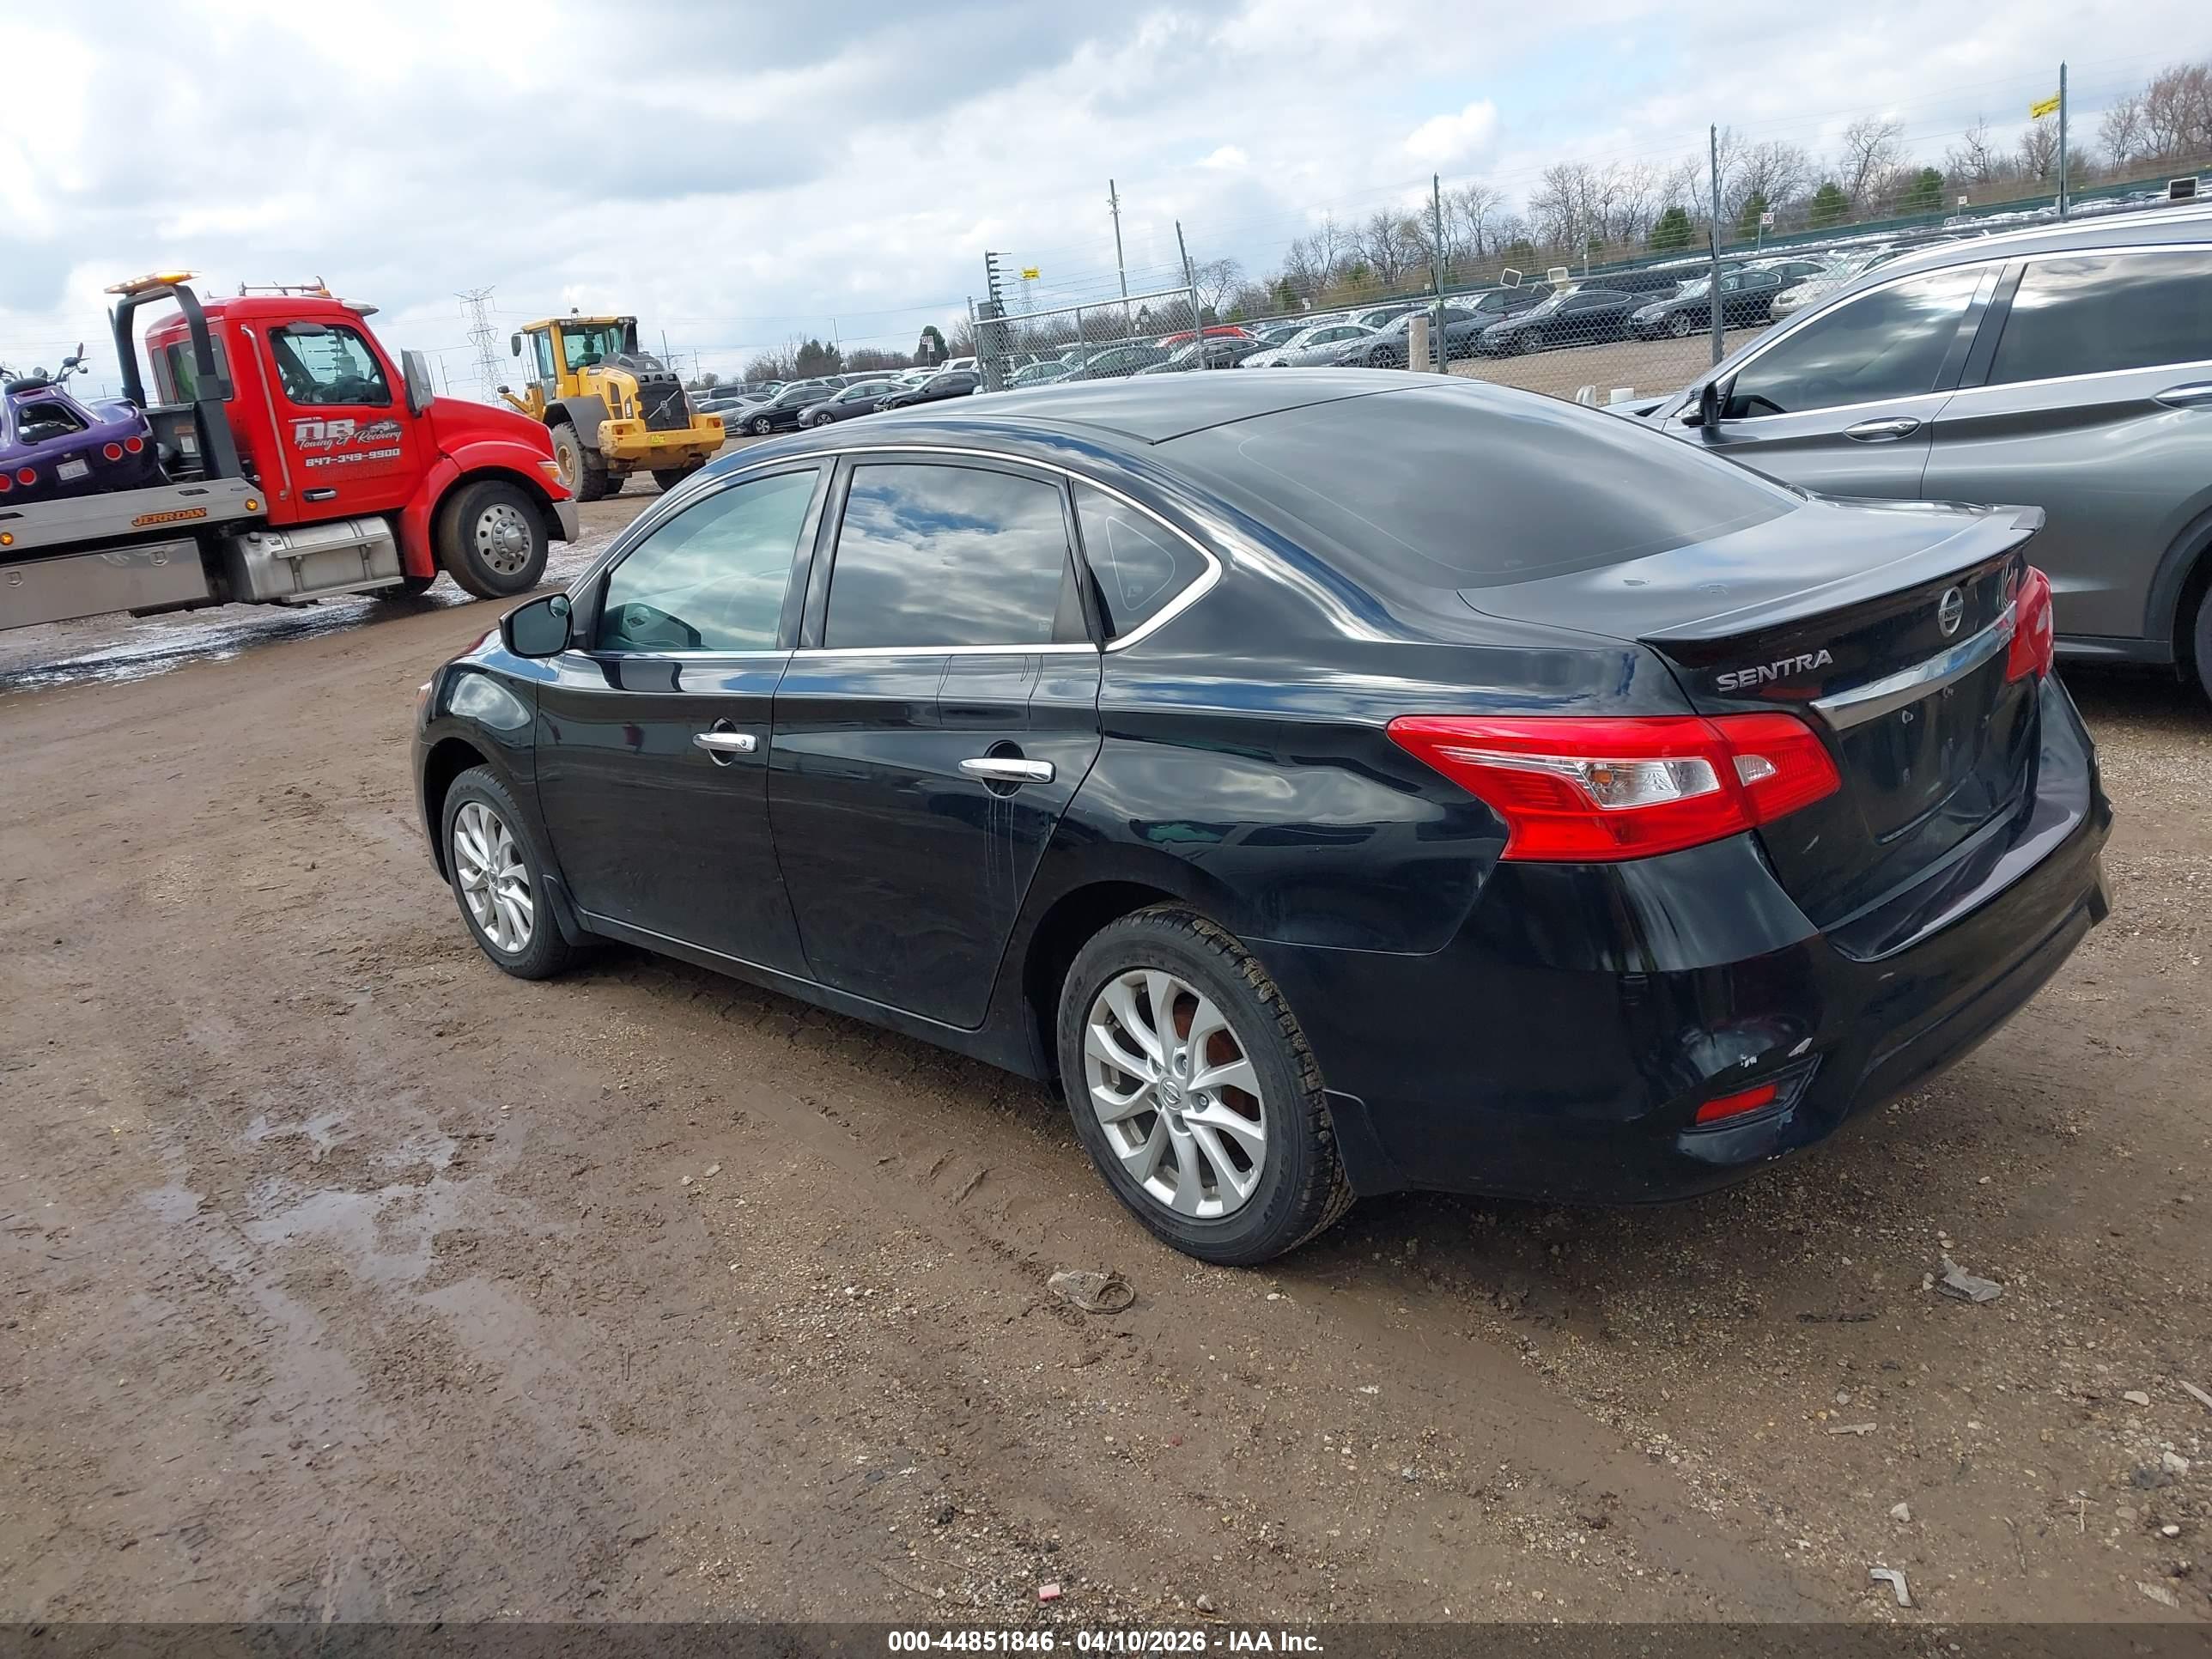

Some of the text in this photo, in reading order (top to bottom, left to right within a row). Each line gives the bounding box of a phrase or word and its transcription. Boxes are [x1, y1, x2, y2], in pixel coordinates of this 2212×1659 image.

[294, 429, 403, 451] Towing & Recovery
[305, 447, 401, 467] 847-349-9900
[1716, 649, 1833, 691] SENTRA
